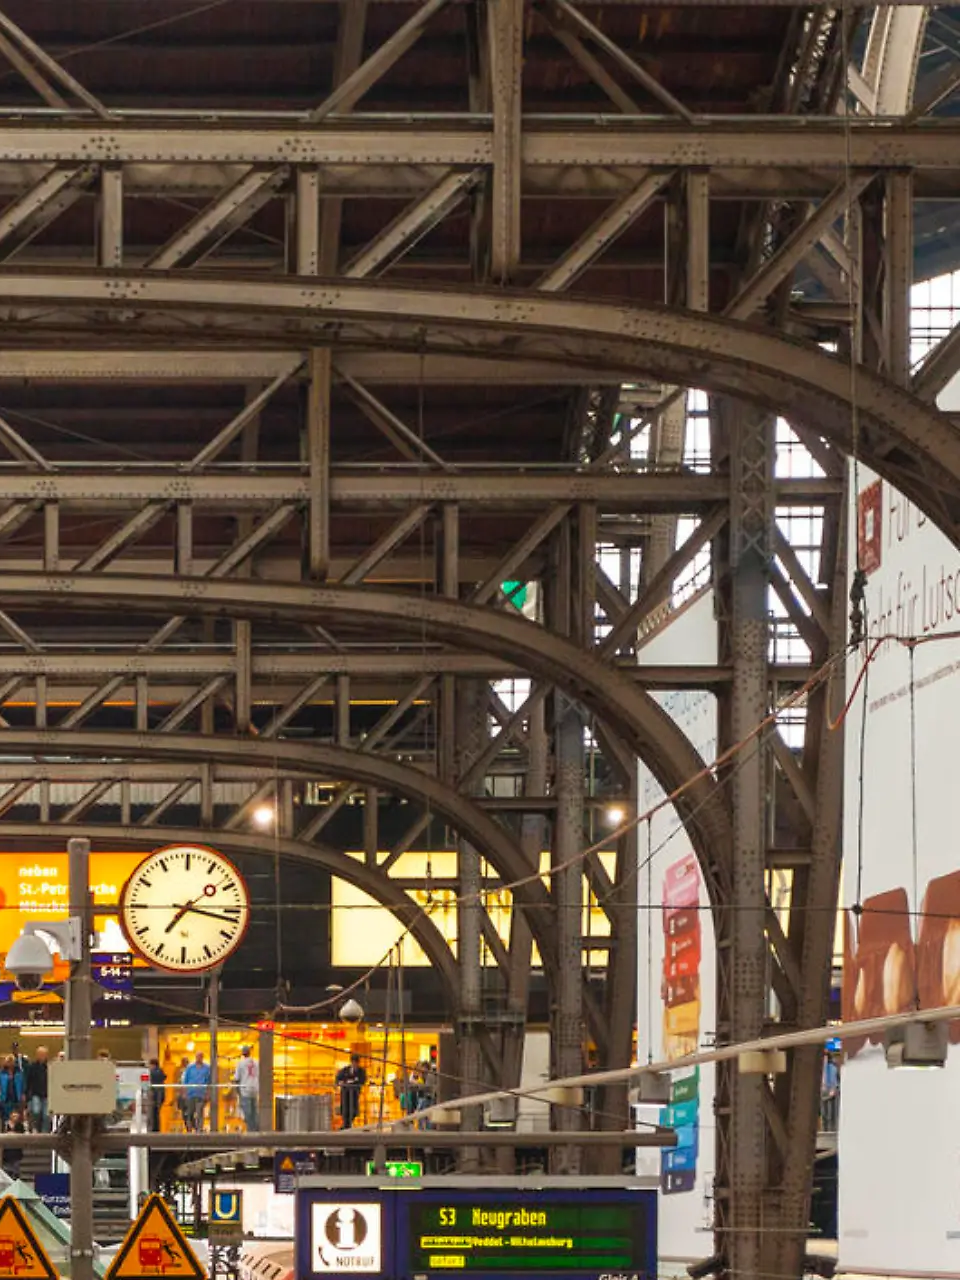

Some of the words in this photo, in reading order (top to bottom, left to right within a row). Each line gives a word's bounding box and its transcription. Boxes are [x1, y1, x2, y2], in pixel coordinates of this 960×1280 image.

[19, 864, 57, 877] neben
[41, 1194, 71, 1204] Kurzzu
[53, 1205, 71, 1215] End
[215, 1194, 237, 1219] U
[439, 1208, 456, 1225] S3
[472, 1207, 546, 1230] Neugraben
